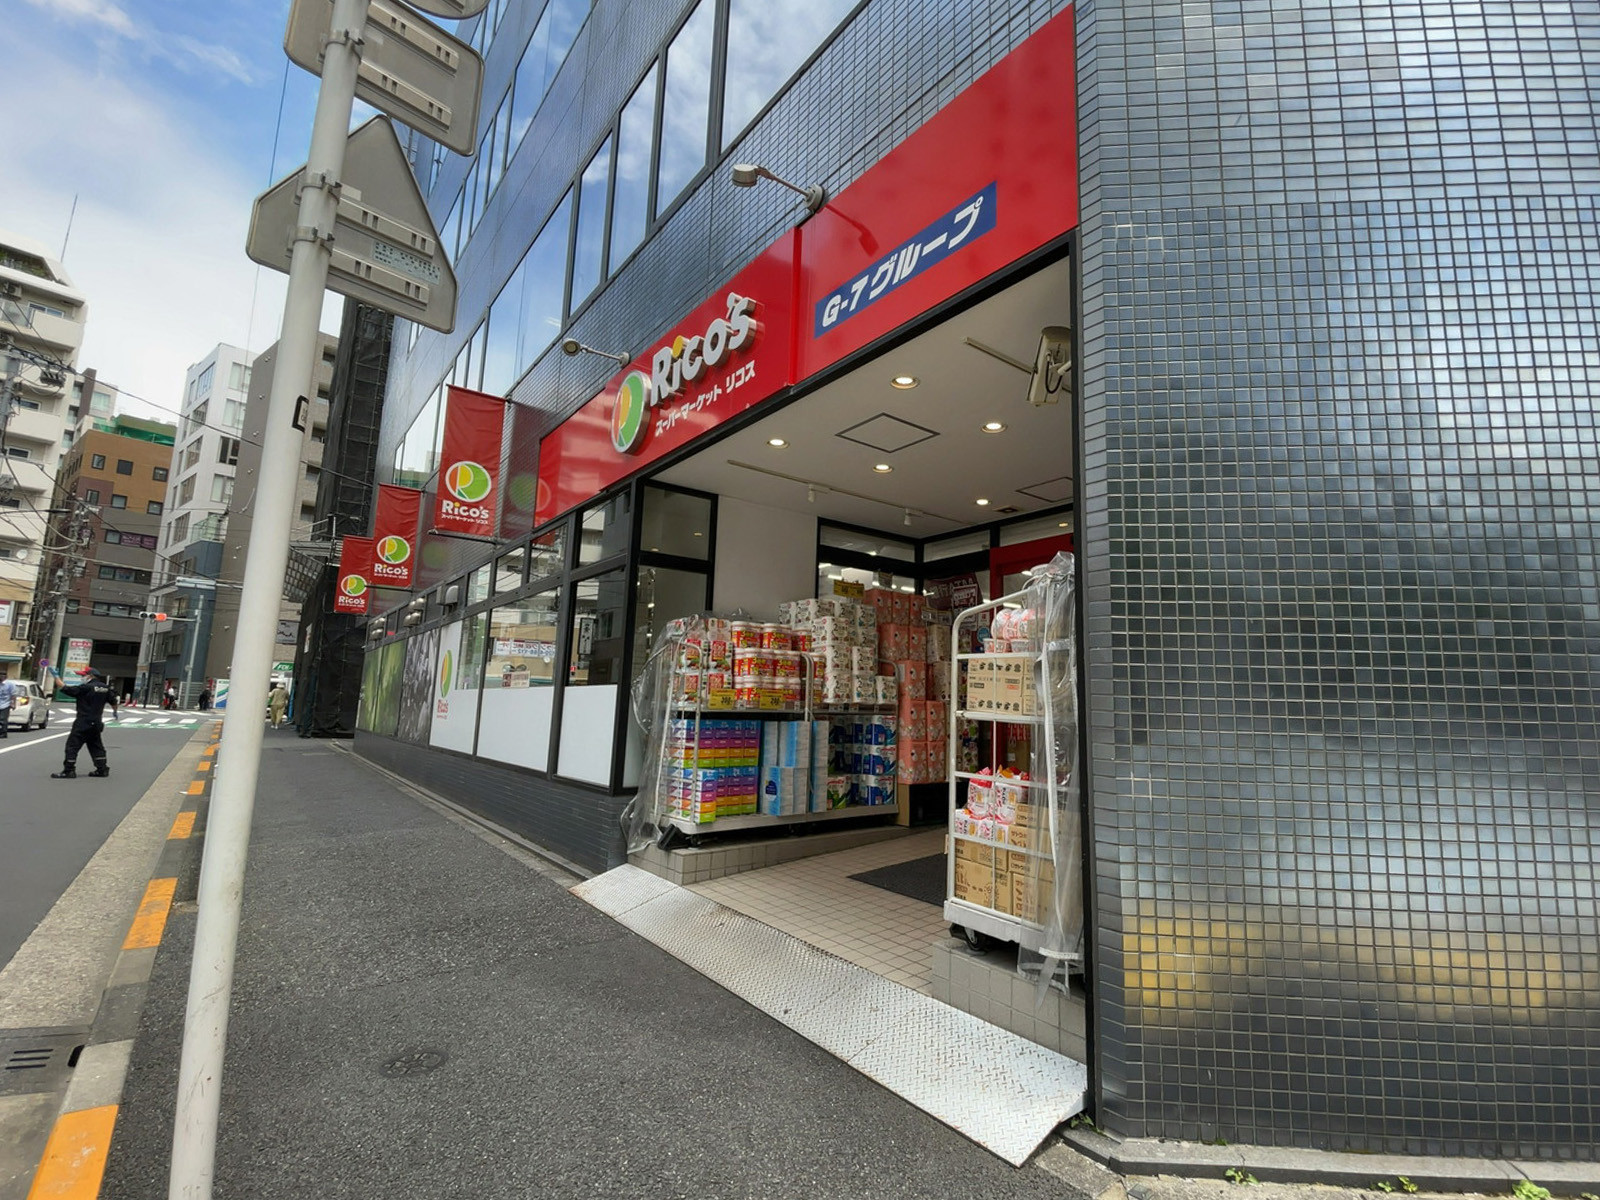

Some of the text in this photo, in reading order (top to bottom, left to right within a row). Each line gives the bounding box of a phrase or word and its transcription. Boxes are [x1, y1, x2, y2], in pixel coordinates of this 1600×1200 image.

[822, 196, 984, 328] G-7グループ
[650, 292, 756, 407] Rico's
[655, 360, 756, 437] スーパーマーケット リコス
[441, 499, 490, 519] Rico's
[374, 563, 408, 575] Rico's
[339, 595, 366, 604] Rico's
